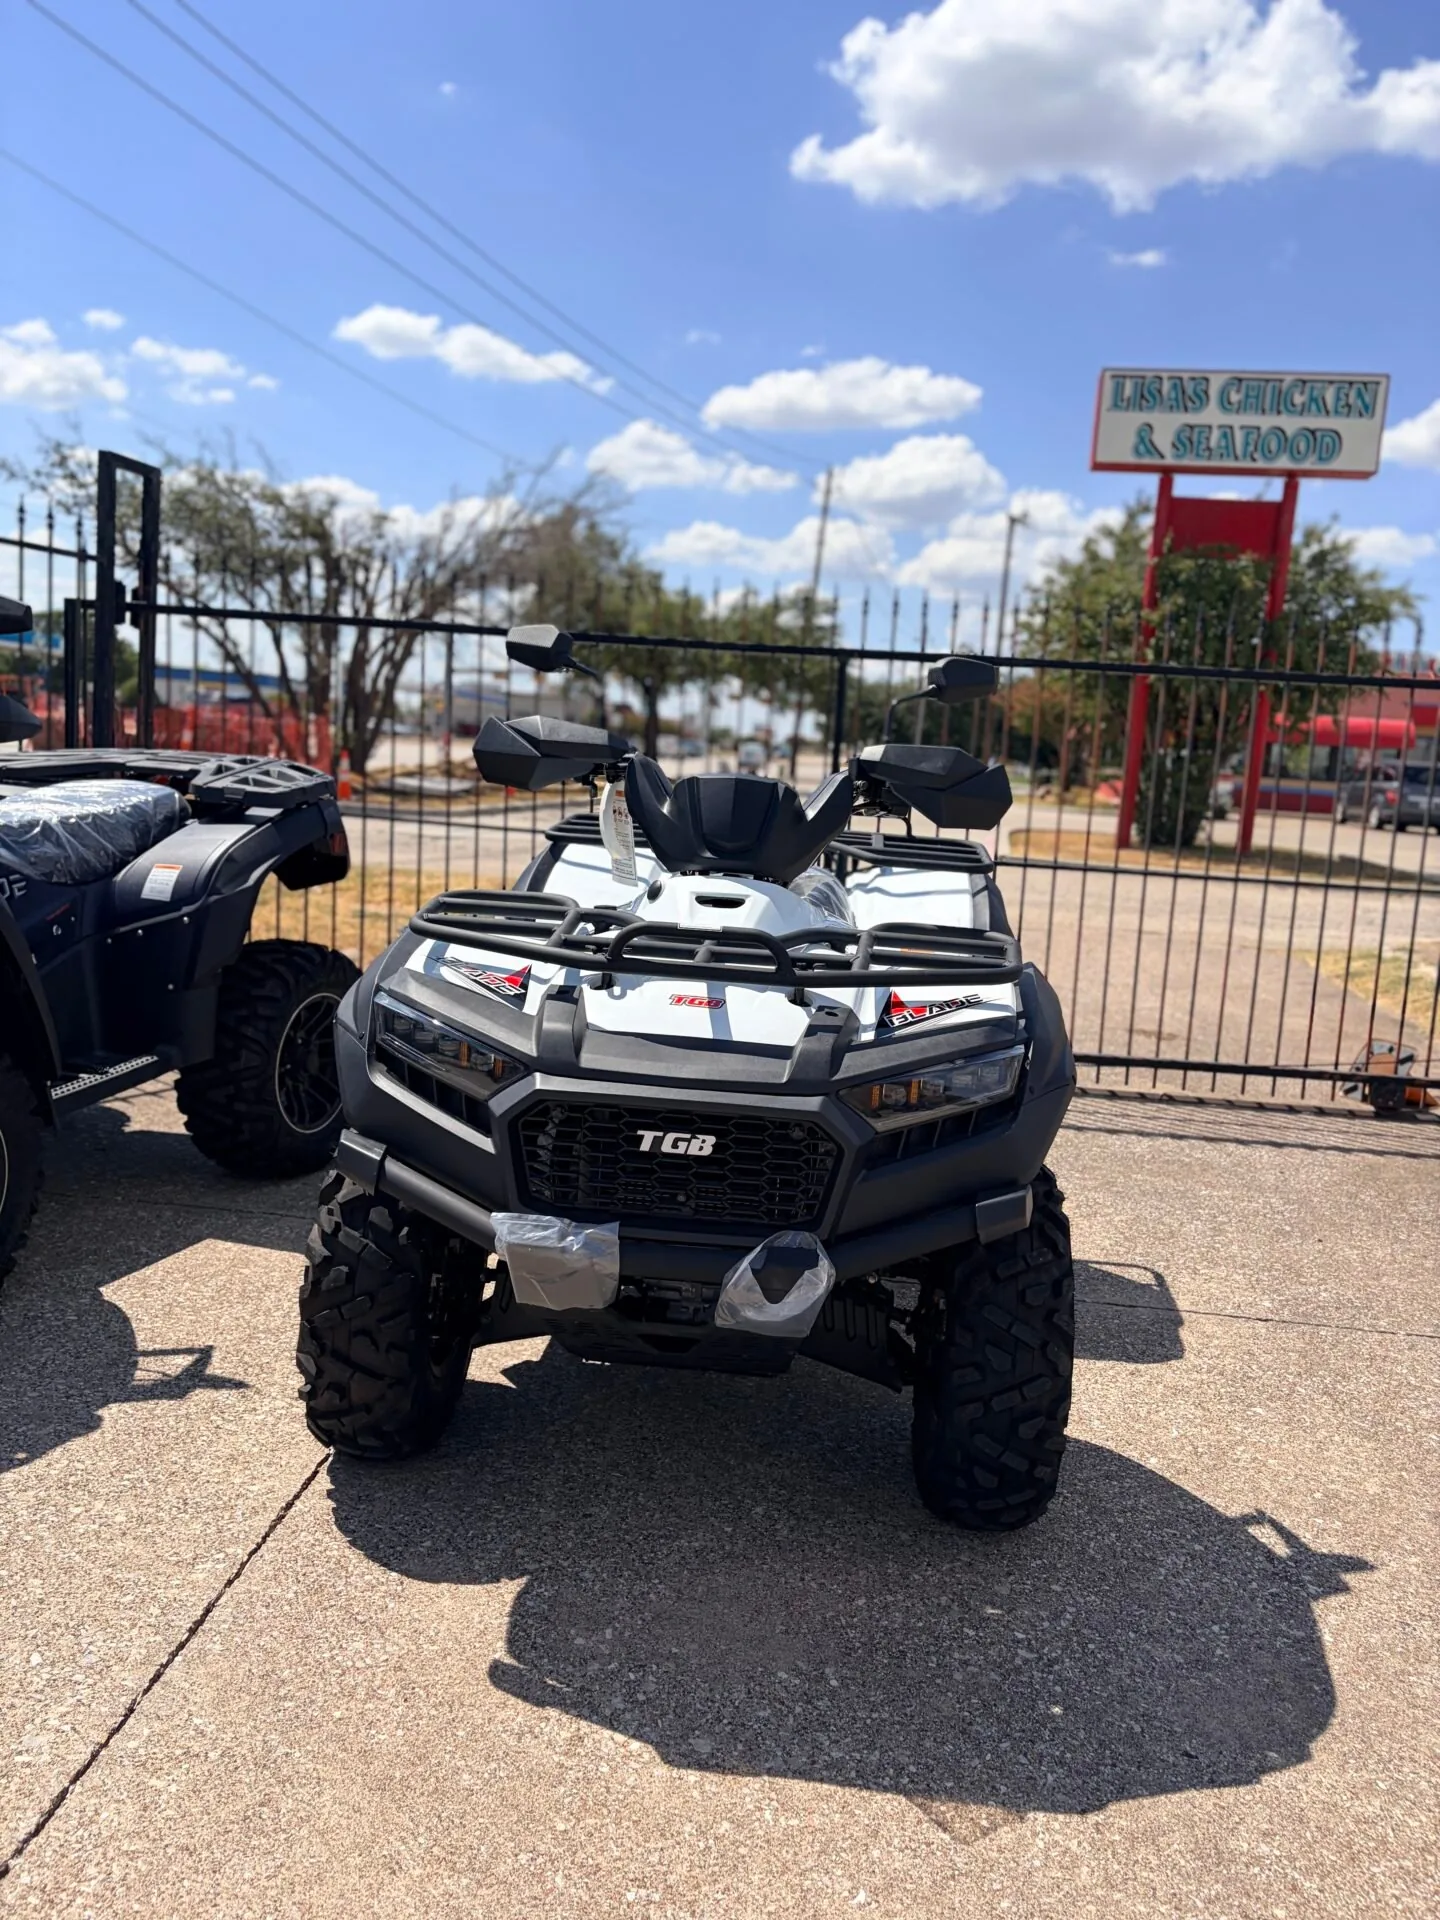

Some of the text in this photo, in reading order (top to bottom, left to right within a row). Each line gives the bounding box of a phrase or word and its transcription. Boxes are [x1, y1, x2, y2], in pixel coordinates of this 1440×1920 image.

[1107, 375, 1381, 419] LISAS CHICKEN
[1131, 423, 1342, 465] & SEAFOOD
[669, 994, 726, 1009] TGB
[884, 993, 983, 1027] BLADE
[637, 1130, 717, 1156] TGB
